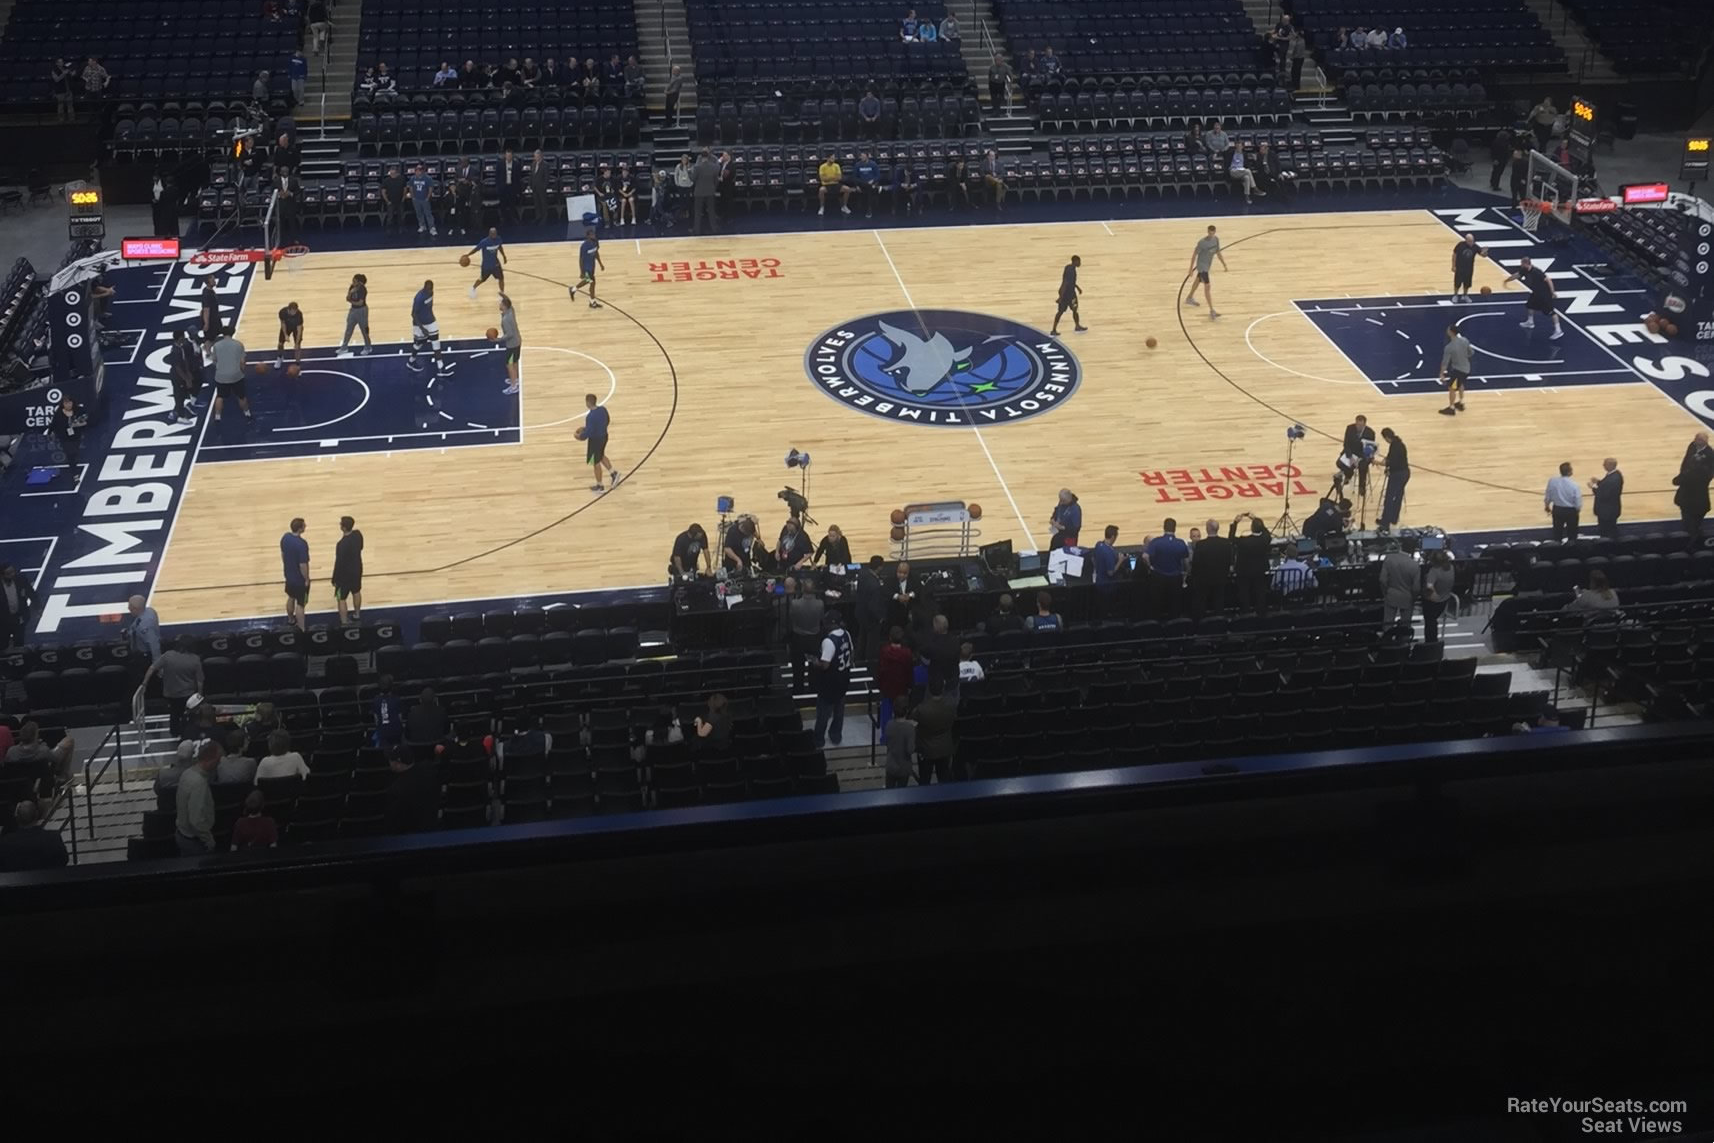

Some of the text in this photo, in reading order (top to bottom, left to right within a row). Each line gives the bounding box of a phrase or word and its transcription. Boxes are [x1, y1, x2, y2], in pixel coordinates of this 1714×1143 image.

[649, 258, 781, 272] CENTER
[651, 269, 785, 282] TARGET
[816, 330, 1071, 423] MINNESOTA TIMBERWOLVES
[1139, 464, 1302, 486] CENTER
[1155, 481, 1318, 503] TARGET
